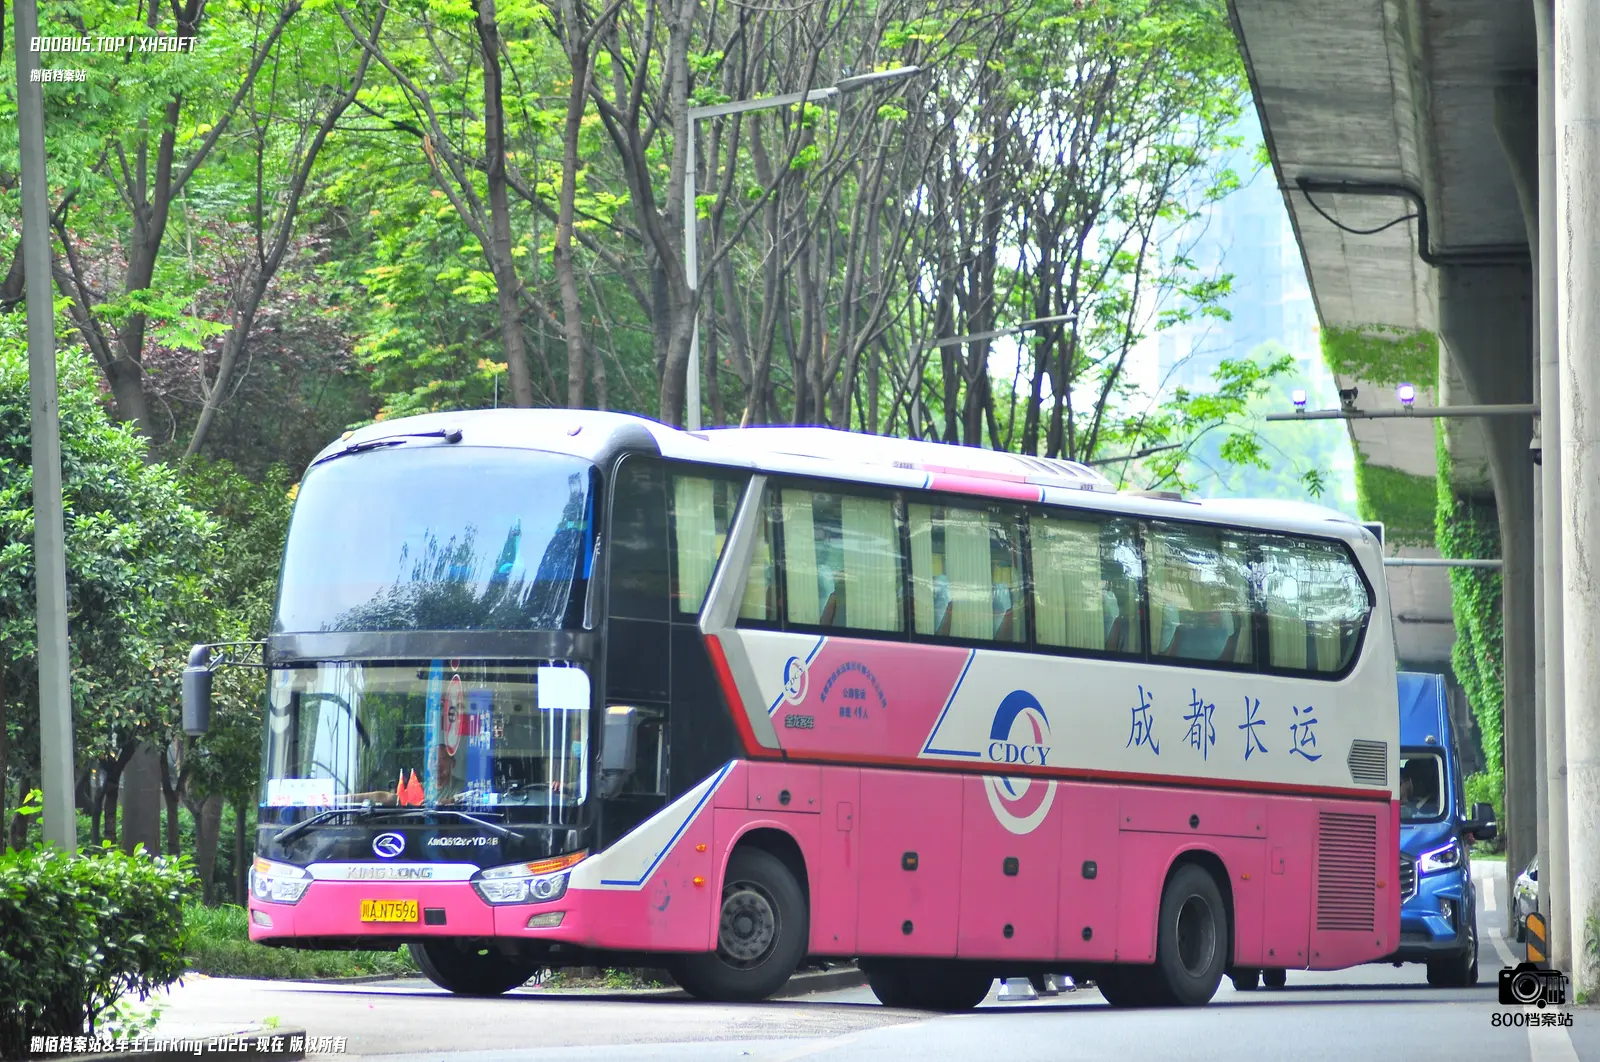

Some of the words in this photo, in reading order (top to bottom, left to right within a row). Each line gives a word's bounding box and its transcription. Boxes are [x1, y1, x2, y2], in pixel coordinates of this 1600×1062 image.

[1126, 685, 1323, 762] 成都长运
[988, 741, 1051, 766] CDCY
